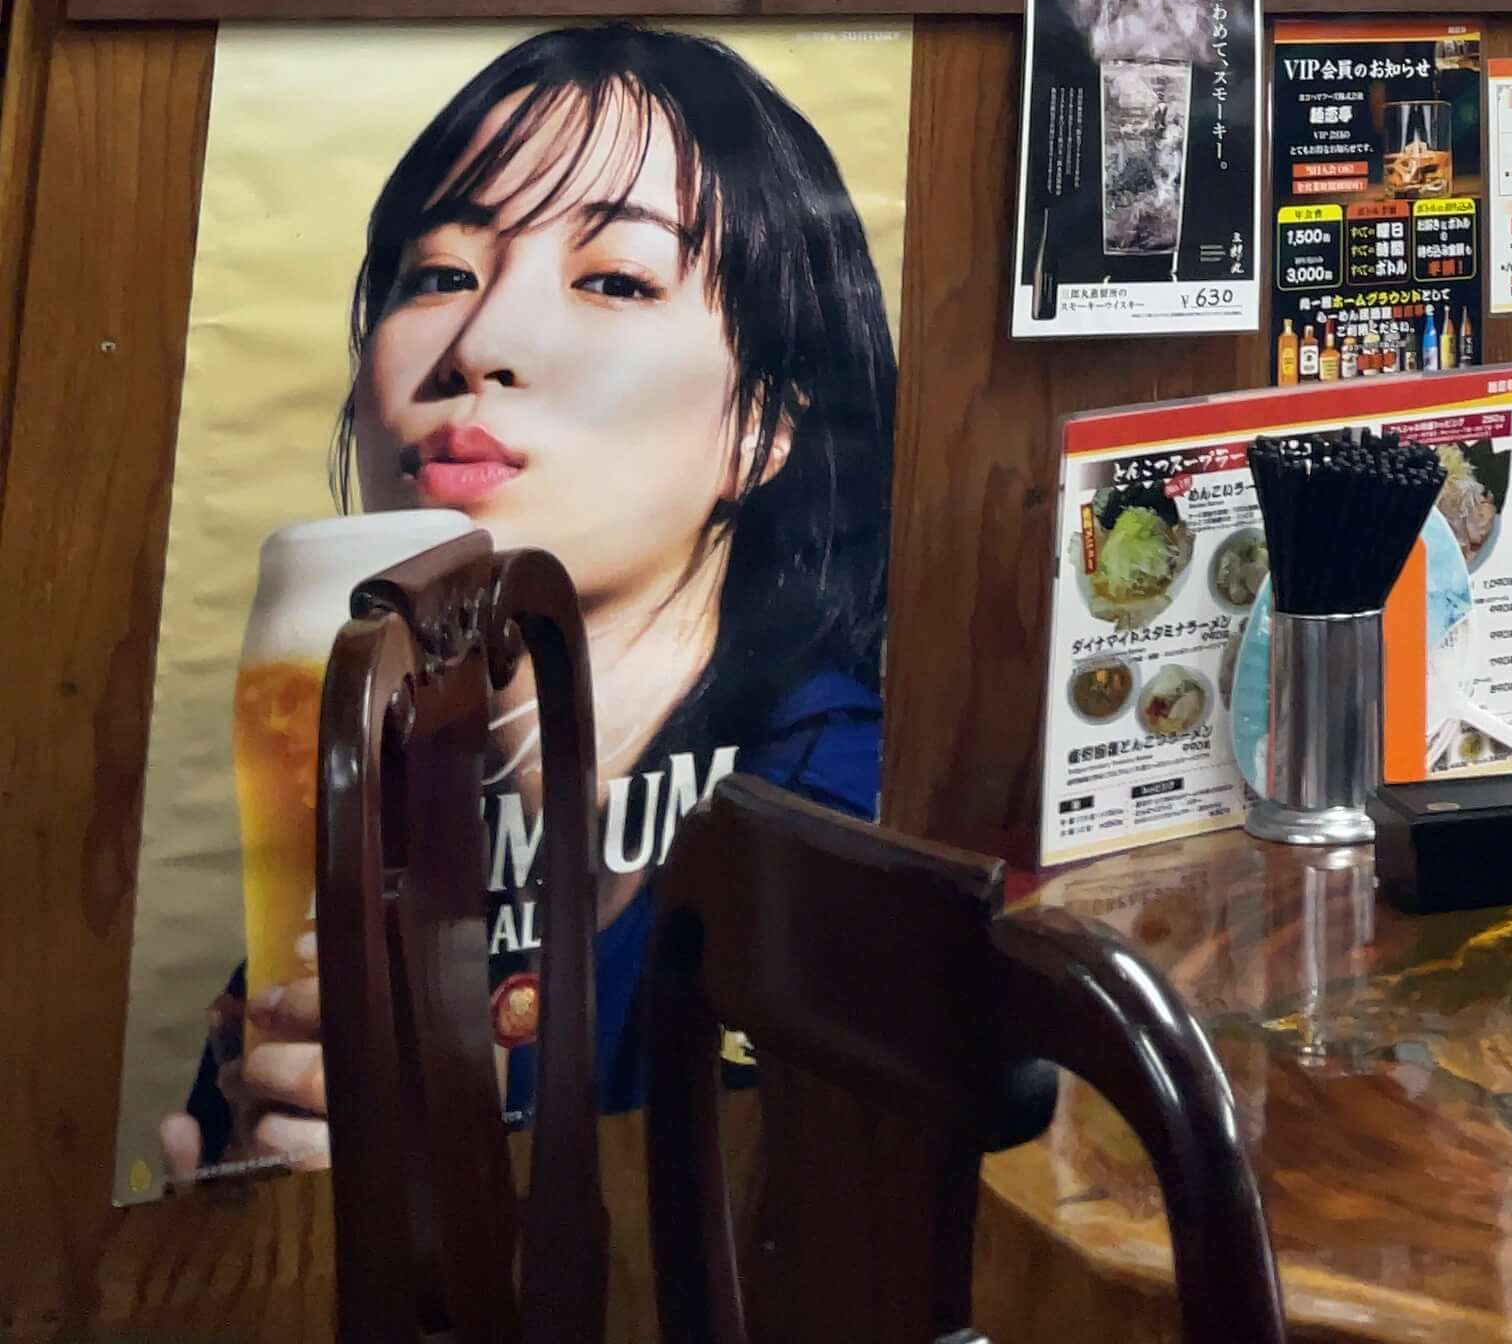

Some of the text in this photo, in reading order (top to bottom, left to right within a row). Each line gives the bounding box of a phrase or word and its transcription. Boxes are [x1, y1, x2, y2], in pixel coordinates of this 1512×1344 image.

[1283, 58, 1432, 82] VIP会員のお知らせ
[1113, 448, 1247, 483] とんこつスープラー
[1187, 480, 1257, 502] めんこいラー
